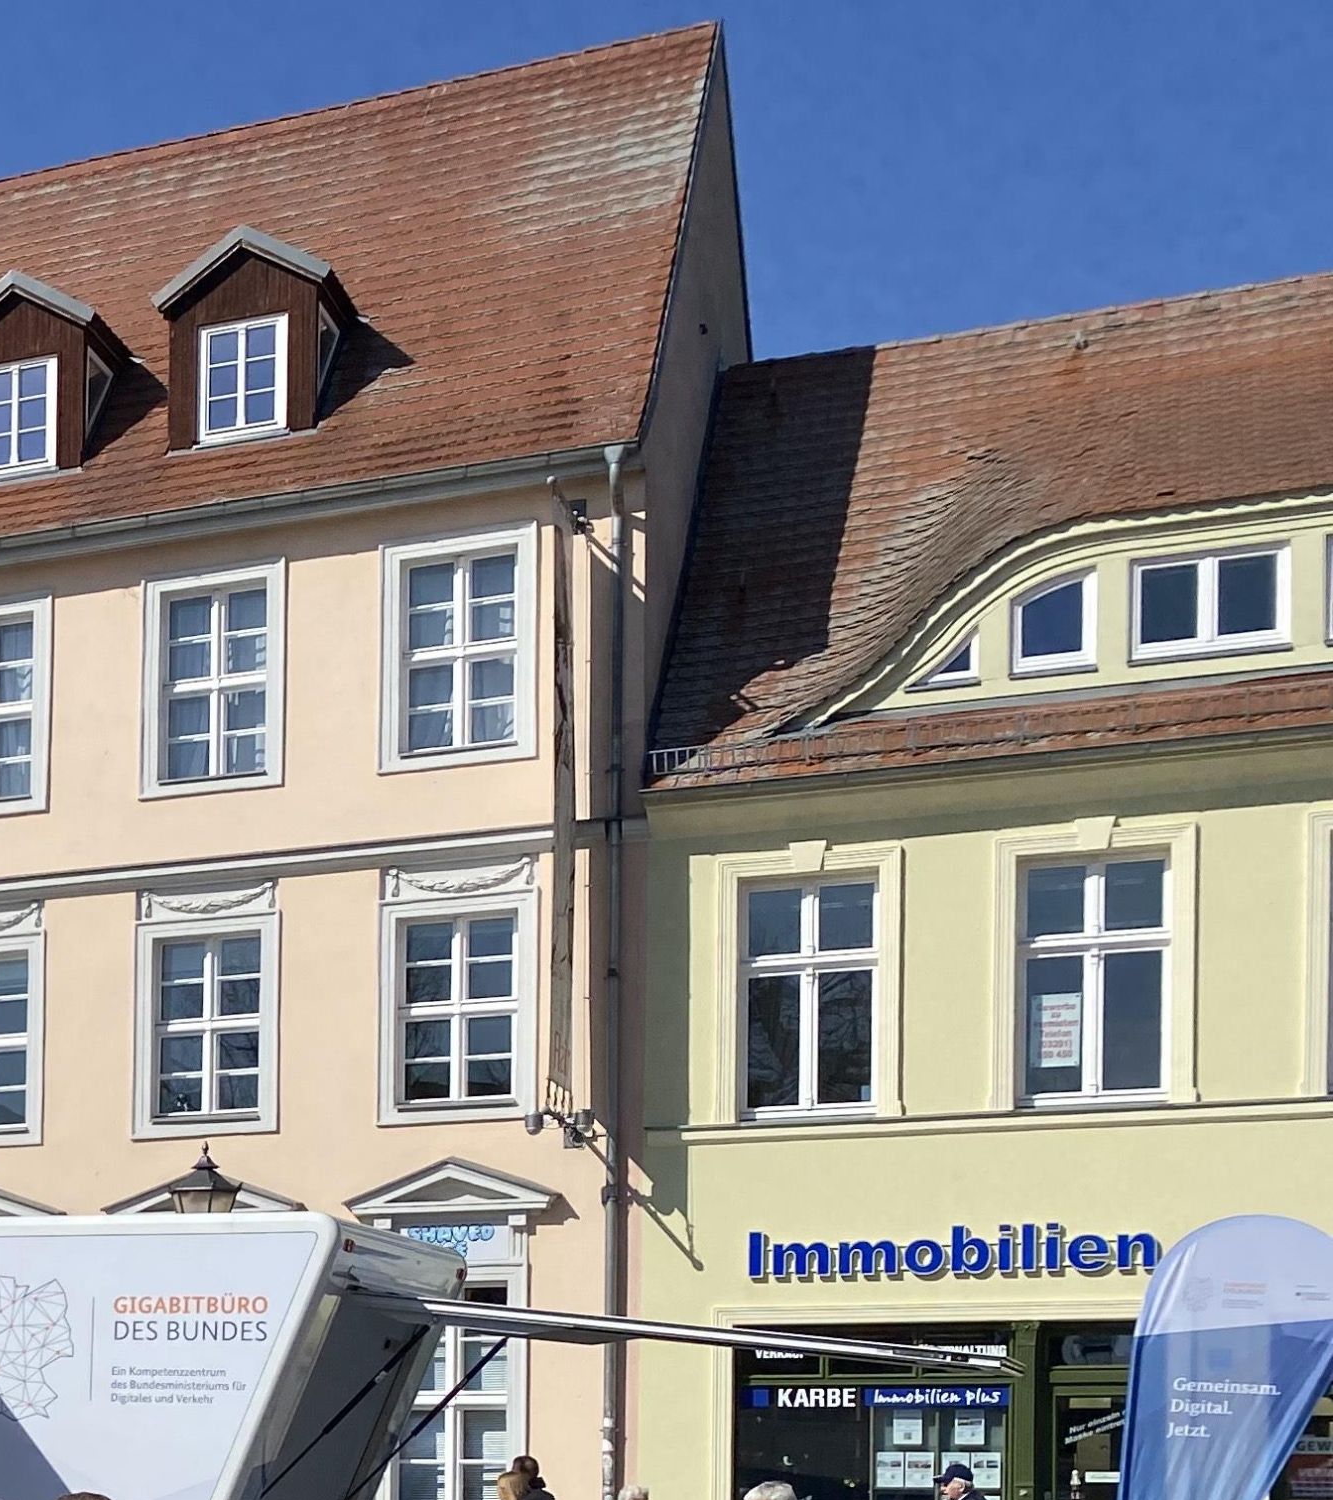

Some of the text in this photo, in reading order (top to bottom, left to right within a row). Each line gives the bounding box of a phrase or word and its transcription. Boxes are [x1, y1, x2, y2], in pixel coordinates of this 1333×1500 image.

[408, 1224, 495, 1243] SHAVED
[749, 1222, 1163, 1278] Immobilien
[113, 1291, 269, 1315] GIGABITBÜRO
[114, 1321, 268, 1342] DES BUNDES
[111, 1366, 226, 1379] Ein Kompetenzzentrum
[111, 1379, 247, 1391] des Bundesministeriums für
[1173, 1377, 1282, 1396] Gemeinsam.
[111, 1392, 215, 1405] Digitales und Verkehr
[777, 1388, 857, 1408] KARBE
[874, 1387, 1002, 1406] Immobilien plus
[1169, 1398, 1234, 1417] Digital.
[1069, 1423, 1086, 1435] Nur
[1166, 1421, 1212, 1439] Jetzt.
